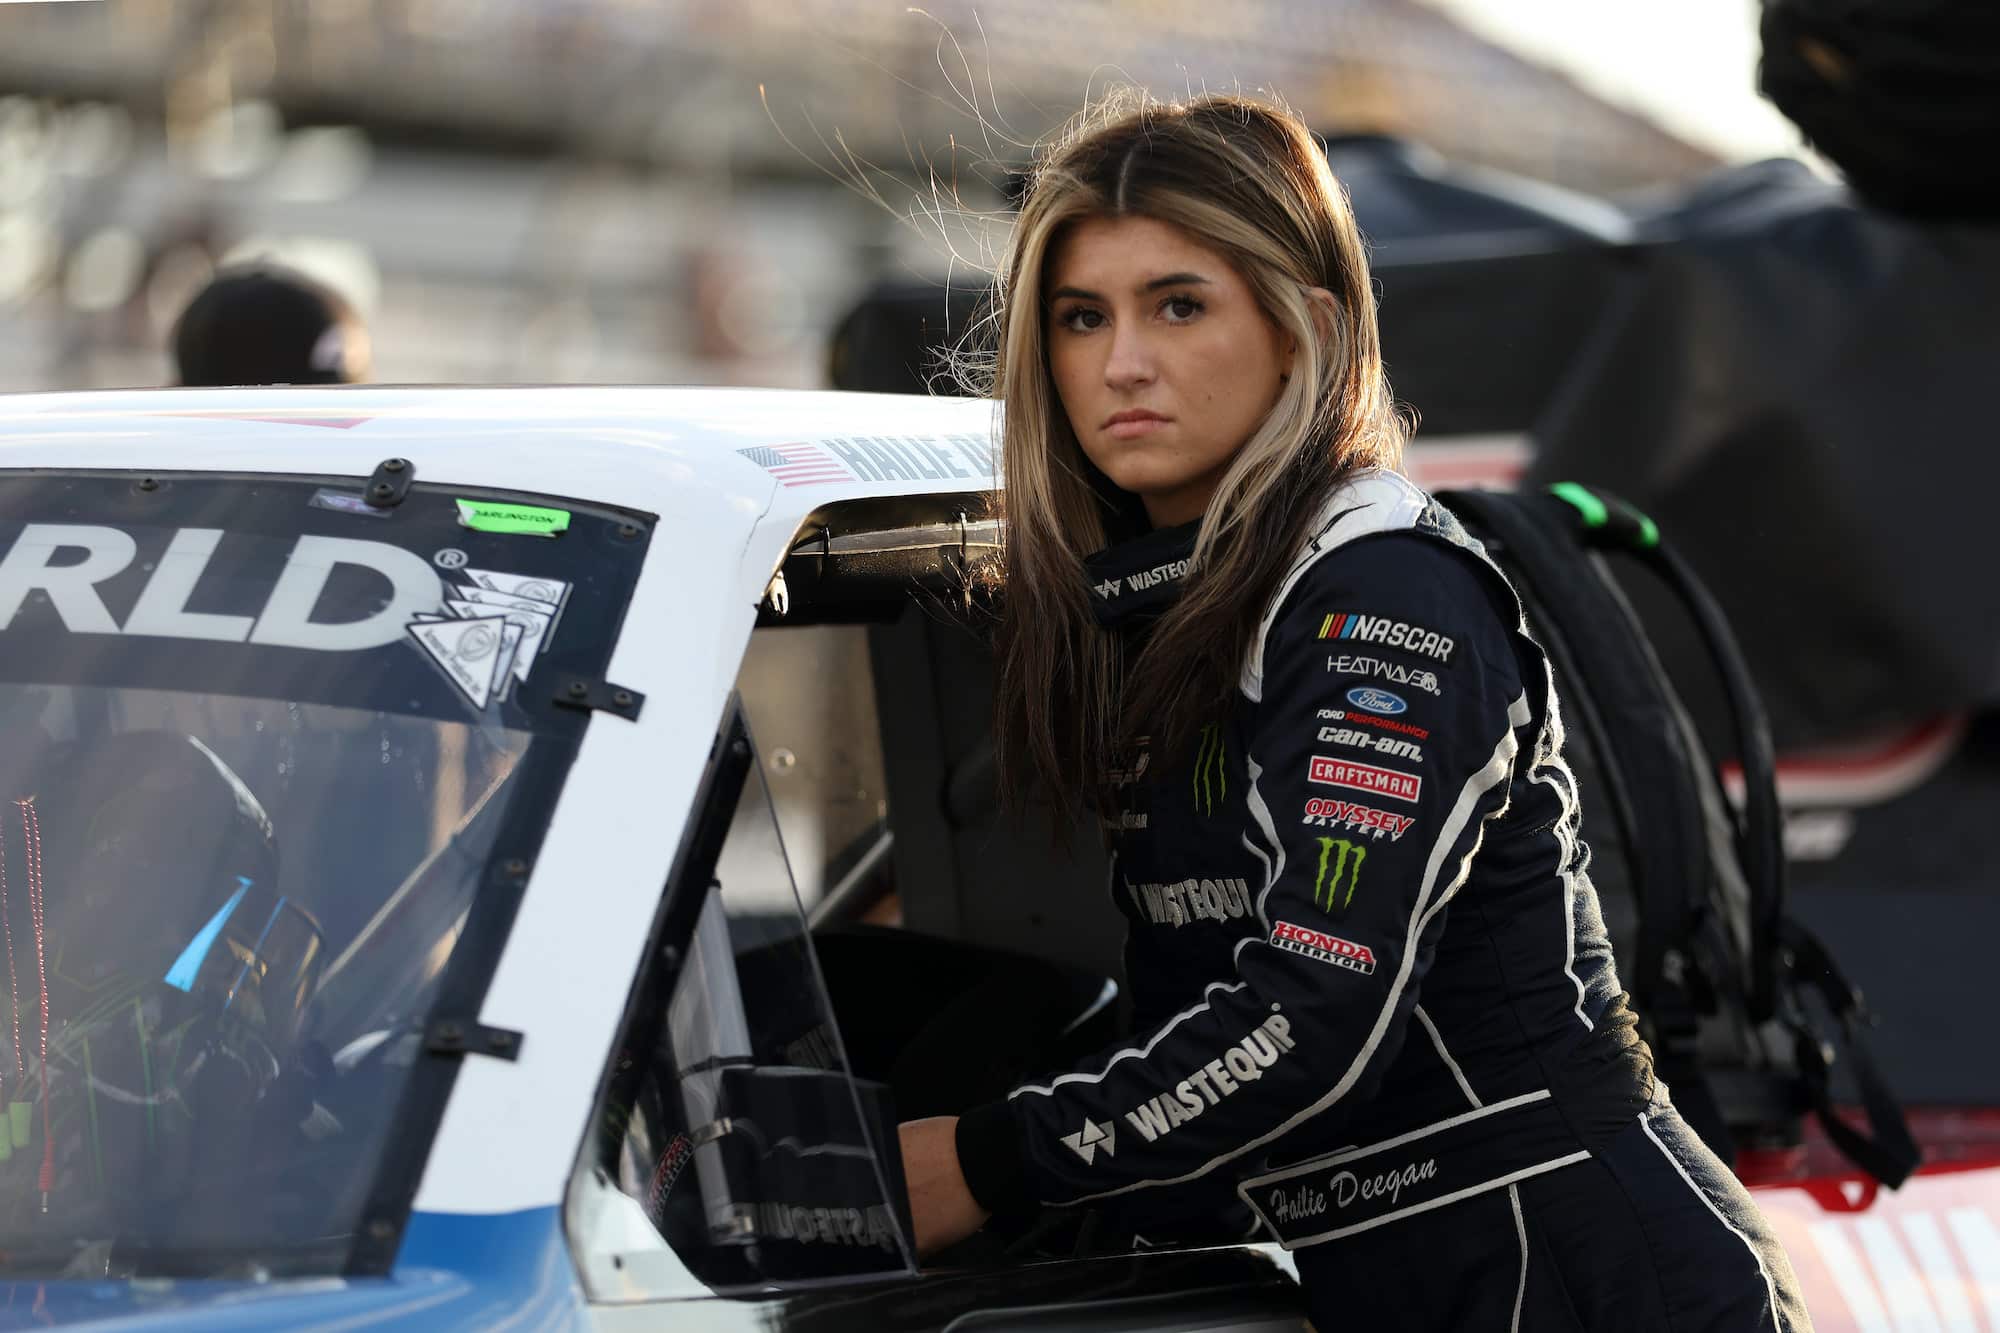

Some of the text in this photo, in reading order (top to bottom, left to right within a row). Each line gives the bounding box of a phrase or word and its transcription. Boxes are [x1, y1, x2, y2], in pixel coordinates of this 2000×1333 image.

[820, 435, 971, 482] HAILIE
[1351, 615, 1454, 663] NASCAR
[1327, 655, 1425, 688] HEATWAVE
[1357, 690, 1395, 713] Ford
[1316, 709, 1430, 740] FORD PERFORMANCE
[1315, 763, 1414, 796] CRAFTSMAN
[1302, 816, 1404, 843] BATTERY
[1305, 797, 1416, 834] ODYSSEY
[1272, 936, 1373, 974] GENERATORS
[1274, 921, 1376, 964] HONDA
[1125, 1013, 1296, 1143] WASTEQUIP
[1270, 1156, 1438, 1224] Hailie Deegan
